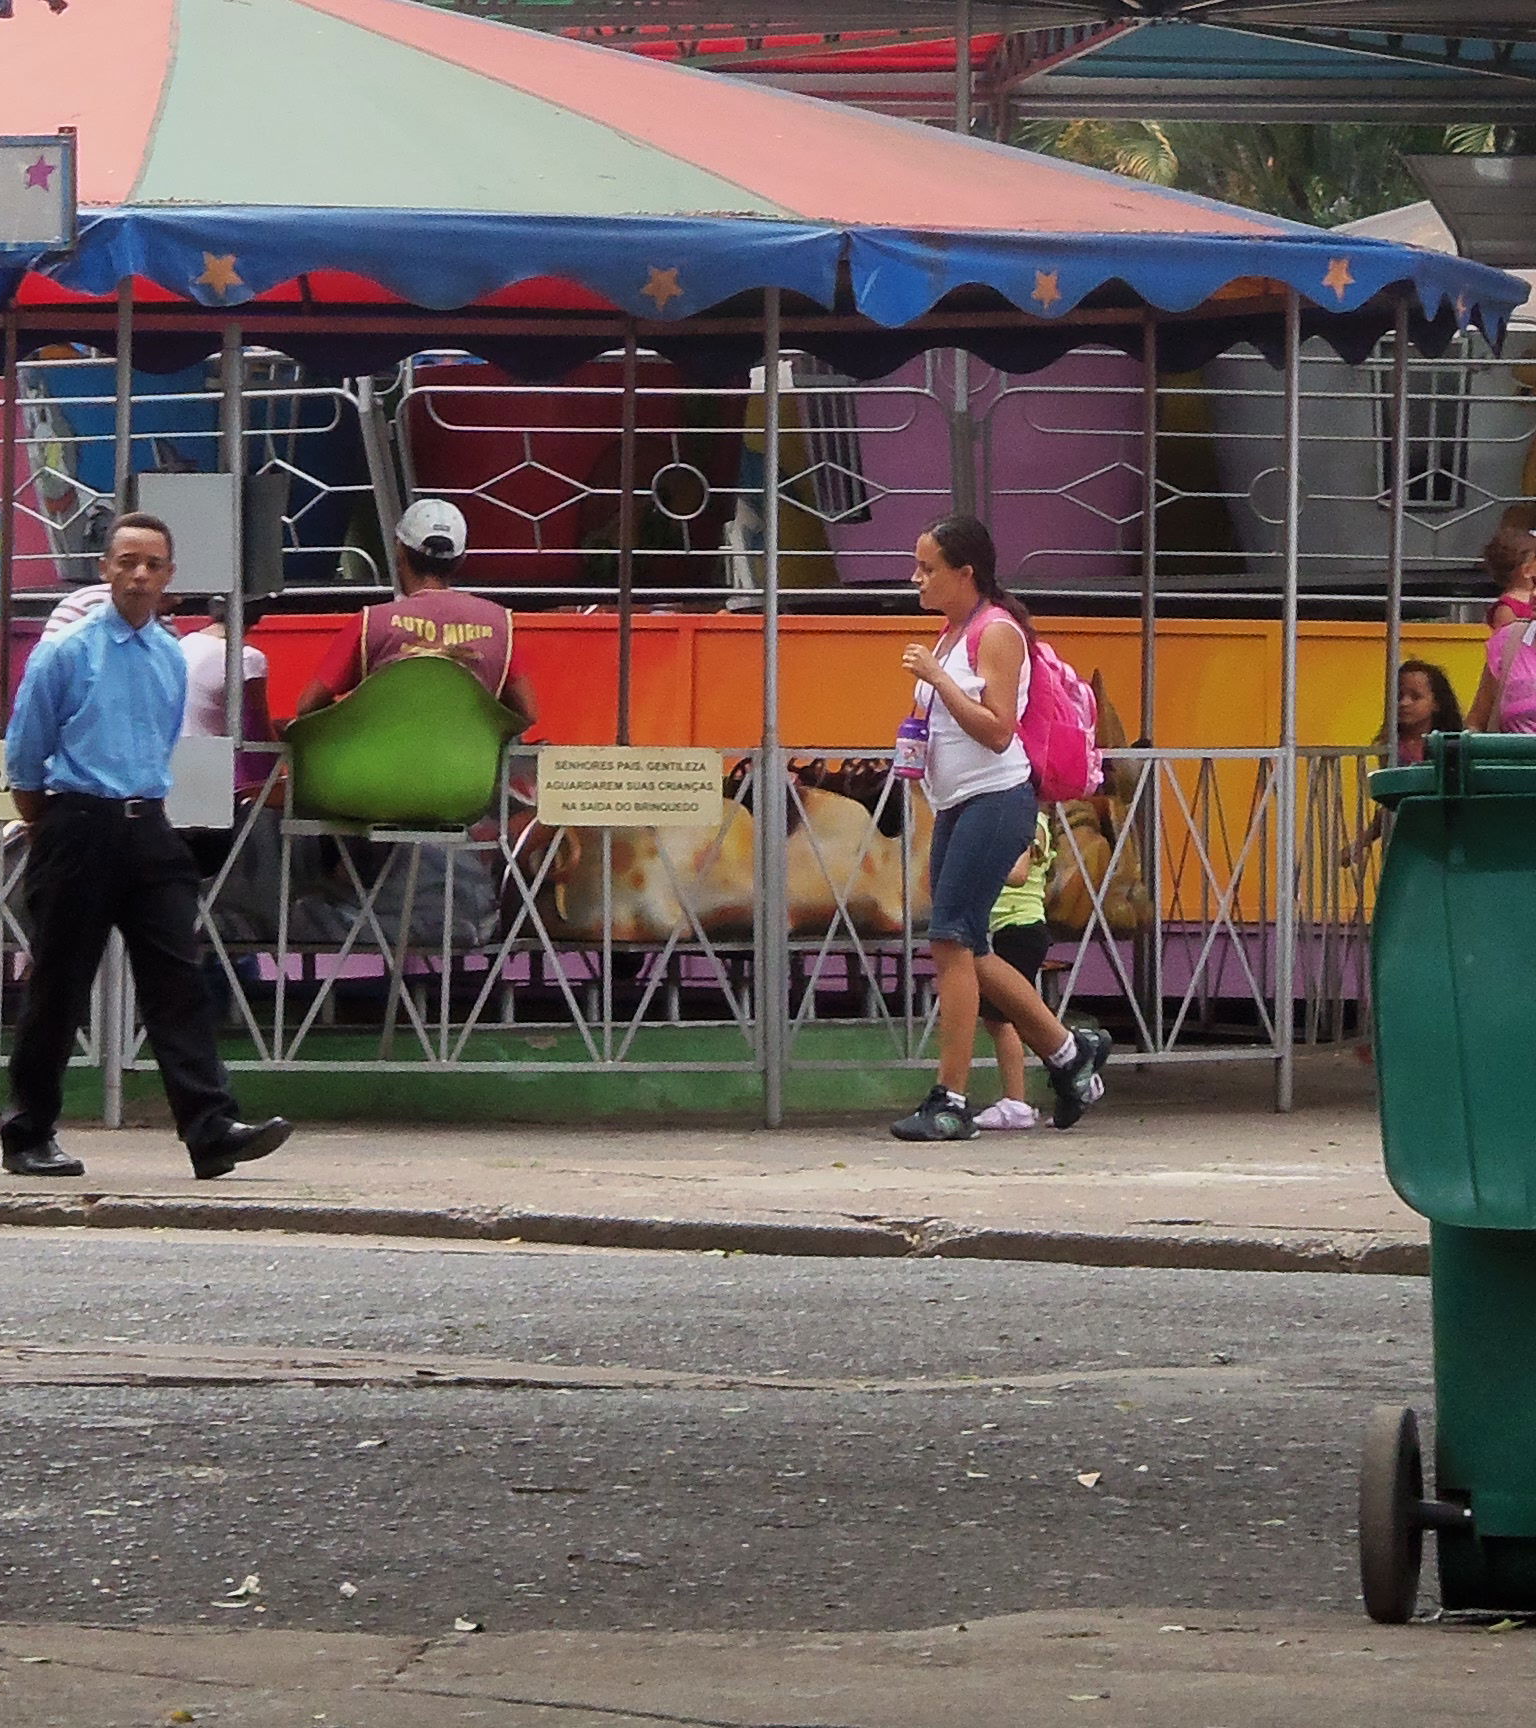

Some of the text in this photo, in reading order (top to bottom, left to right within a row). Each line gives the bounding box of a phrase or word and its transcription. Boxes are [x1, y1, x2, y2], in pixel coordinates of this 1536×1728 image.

[391, 615, 436, 642] AUTO
[554, 760, 614, 771] SENHORES
[646, 761, 706, 772] GENTILEZA
[545, 780, 623, 791] AGUARDAREM
[626, 781, 655, 791] SUAS
[562, 802, 577, 812] NA
[614, 802, 632, 812] DO
[634, 802, 699, 812] BRINQUEDO
